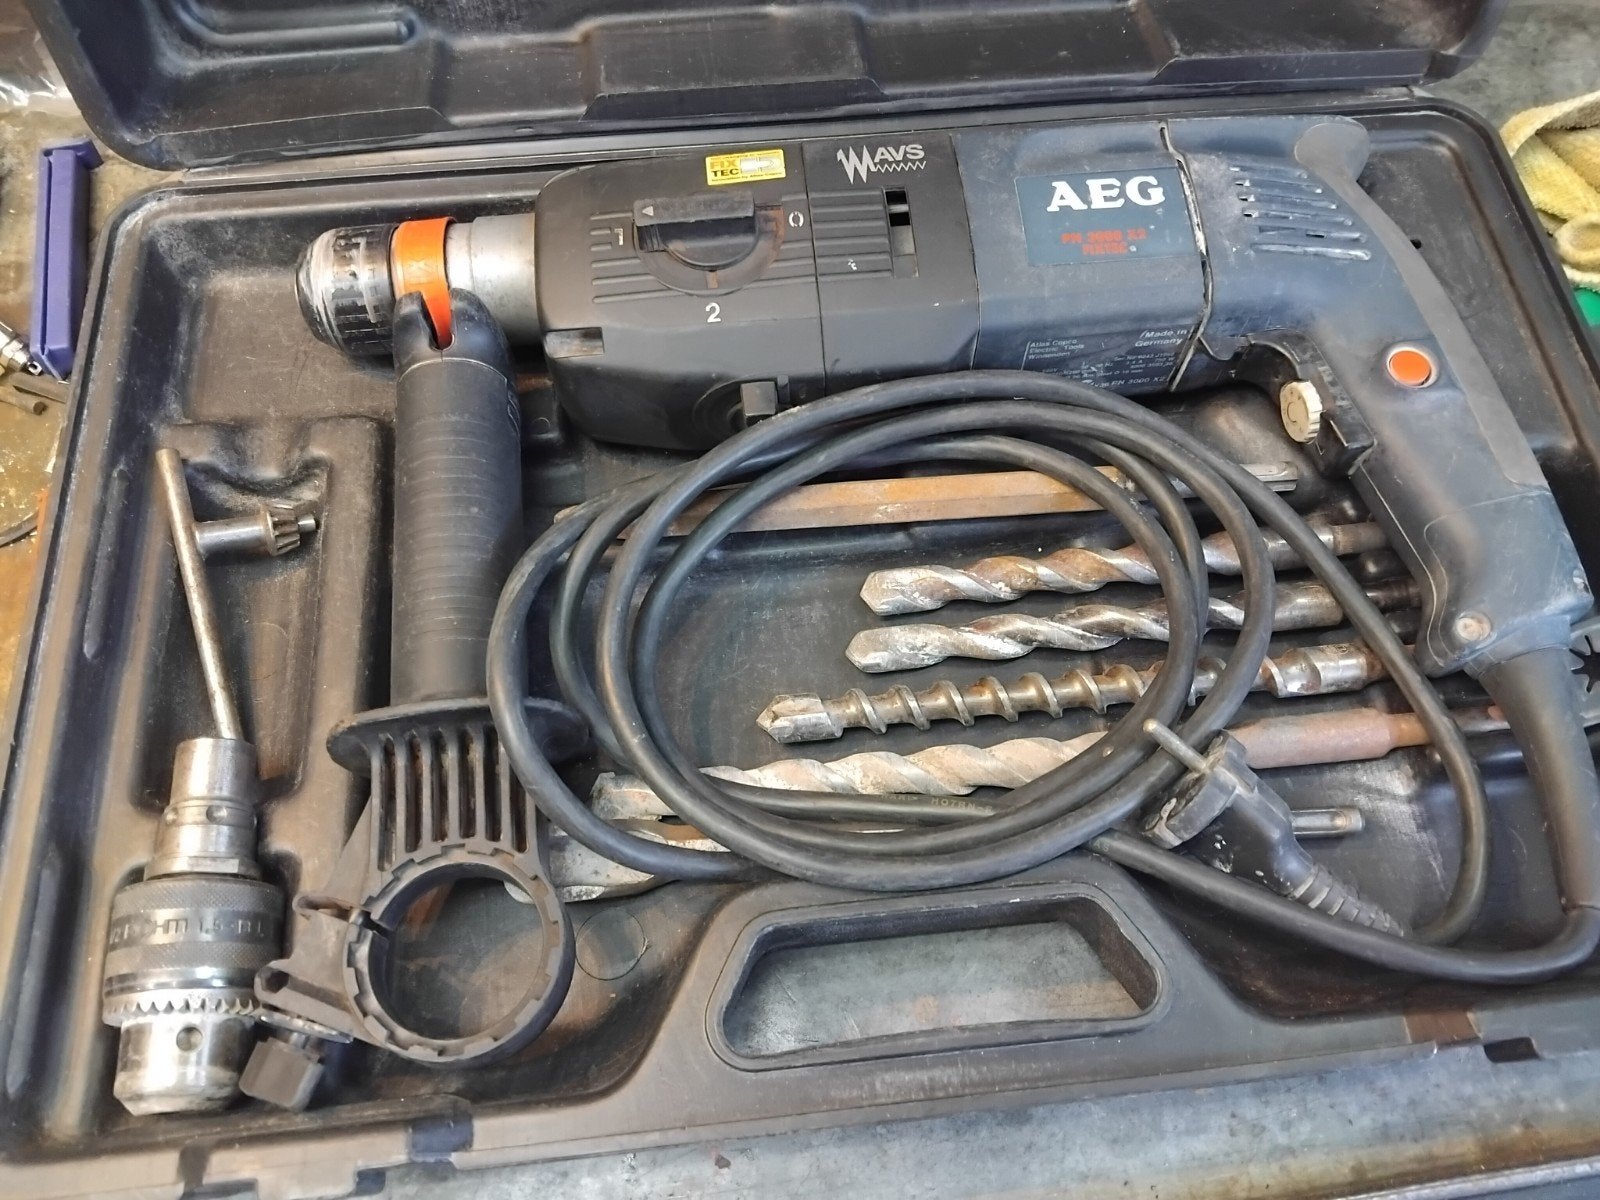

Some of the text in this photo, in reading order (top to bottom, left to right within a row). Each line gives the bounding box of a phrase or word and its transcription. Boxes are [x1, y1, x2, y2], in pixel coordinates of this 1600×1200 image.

[710, 159, 738, 169] FIX
[711, 168, 740, 178] TEC
[1046, 175, 1166, 212] AEG
[704, 302, 722, 323] 2
[1144, 330, 1174, 338] Made
[1030, 339, 1078, 349] Atlas Copco
[1135, 338, 1183, 347] Germany
